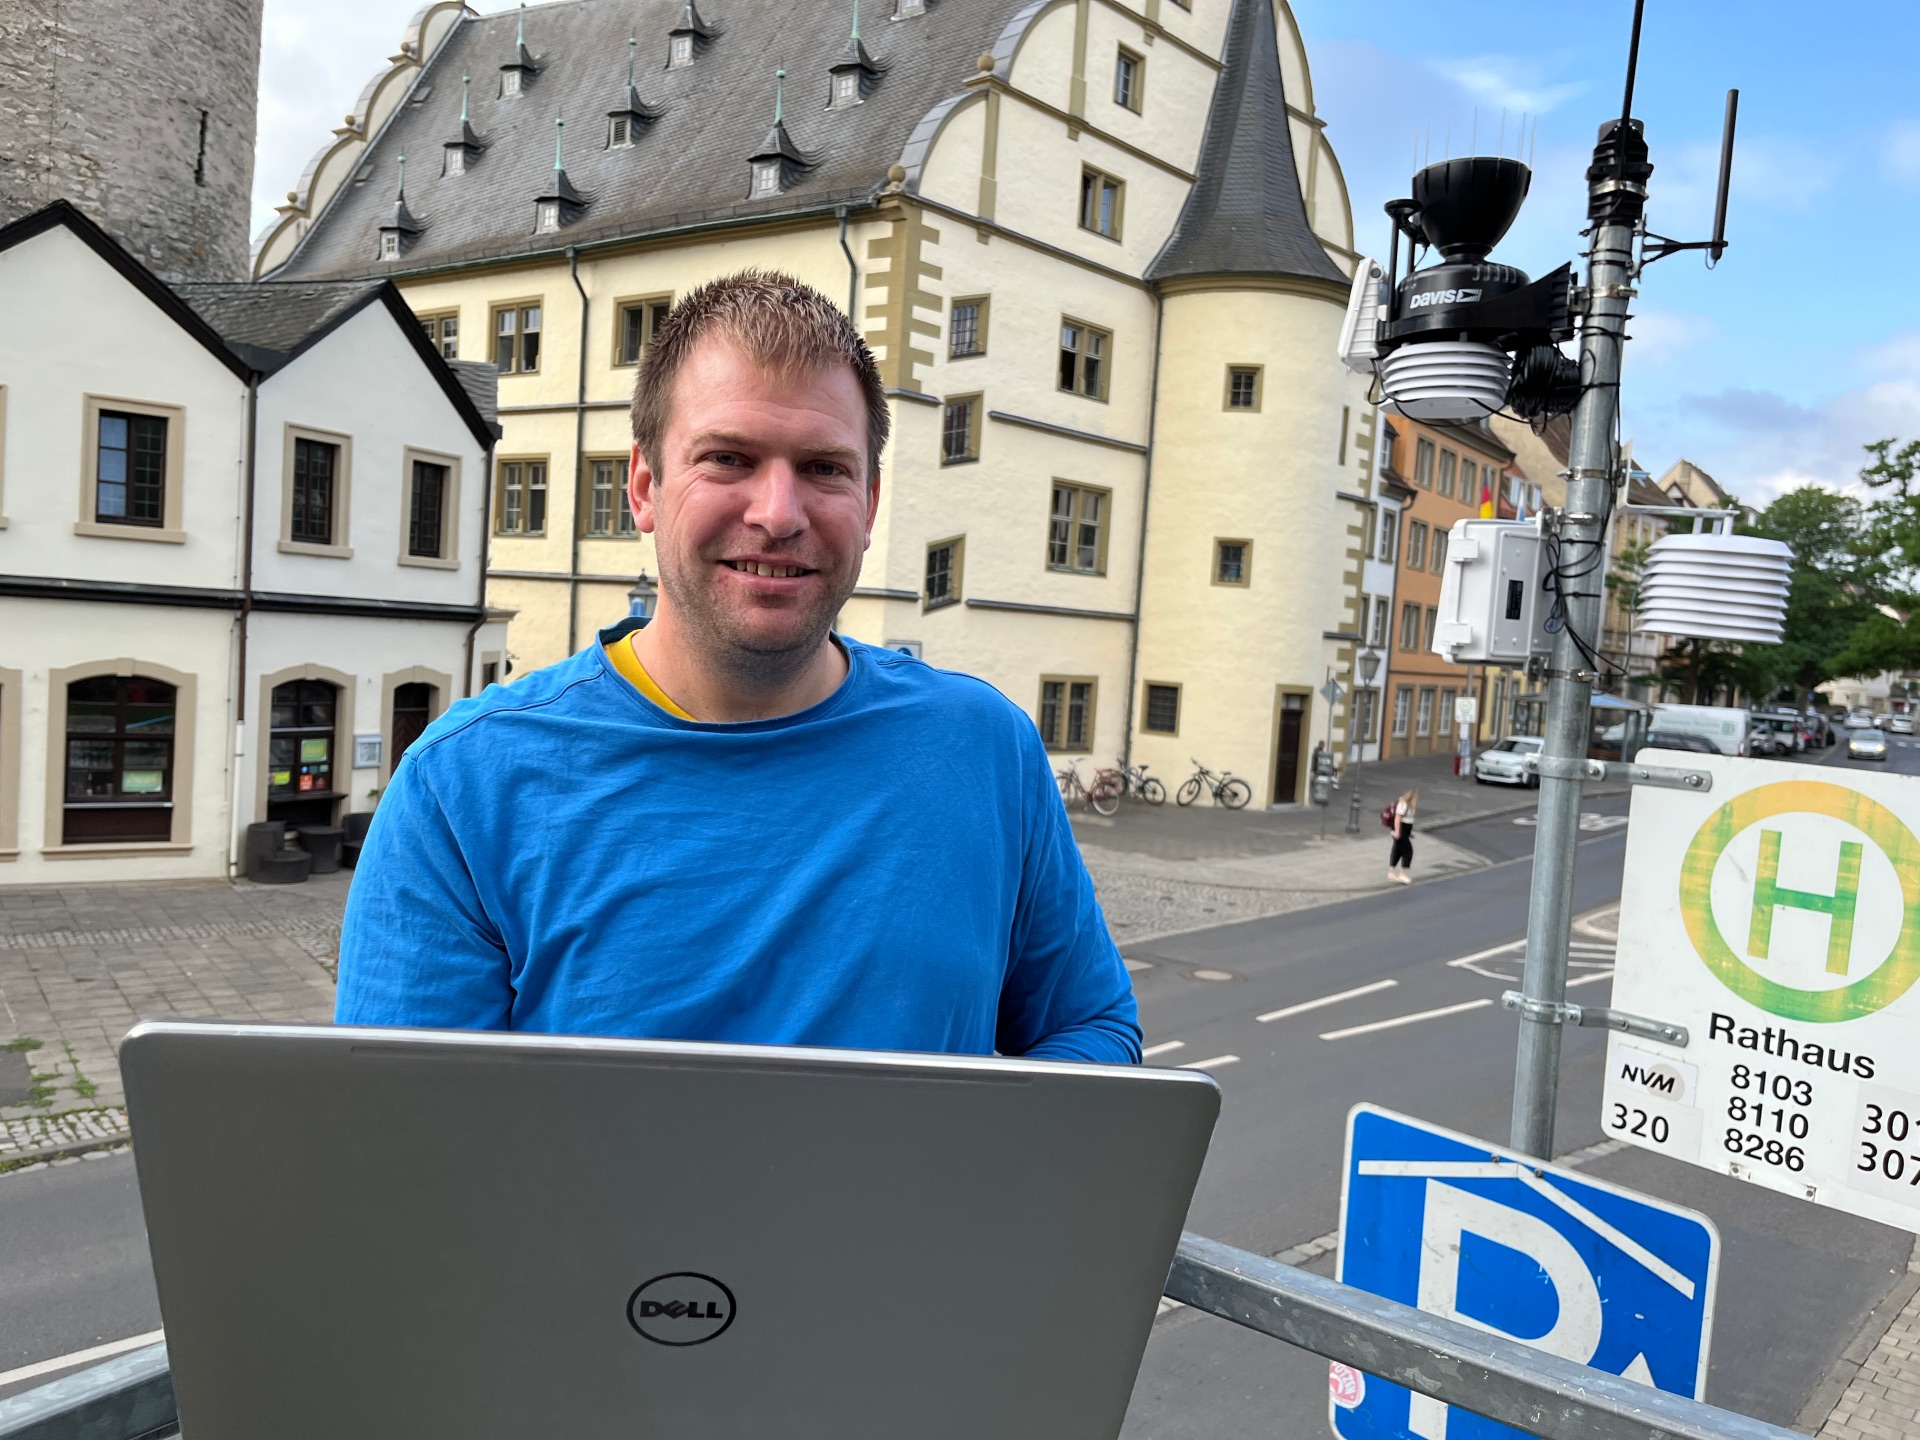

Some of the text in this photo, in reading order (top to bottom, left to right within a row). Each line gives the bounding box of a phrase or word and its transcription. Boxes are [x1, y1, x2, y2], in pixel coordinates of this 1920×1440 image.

[1746, 828, 1864, 977] H
[1709, 1011, 1876, 1079] Rathaus
[1620, 1063, 1676, 1094] NVM
[1730, 1063, 1813, 1107] 8103
[1611, 1102, 1669, 1143] 320
[1727, 1096, 1809, 1139] 8110
[1862, 1103, 1920, 1142] 30
[1723, 1127, 1805, 1172] 8286
[639, 1299, 724, 1320] DELL
